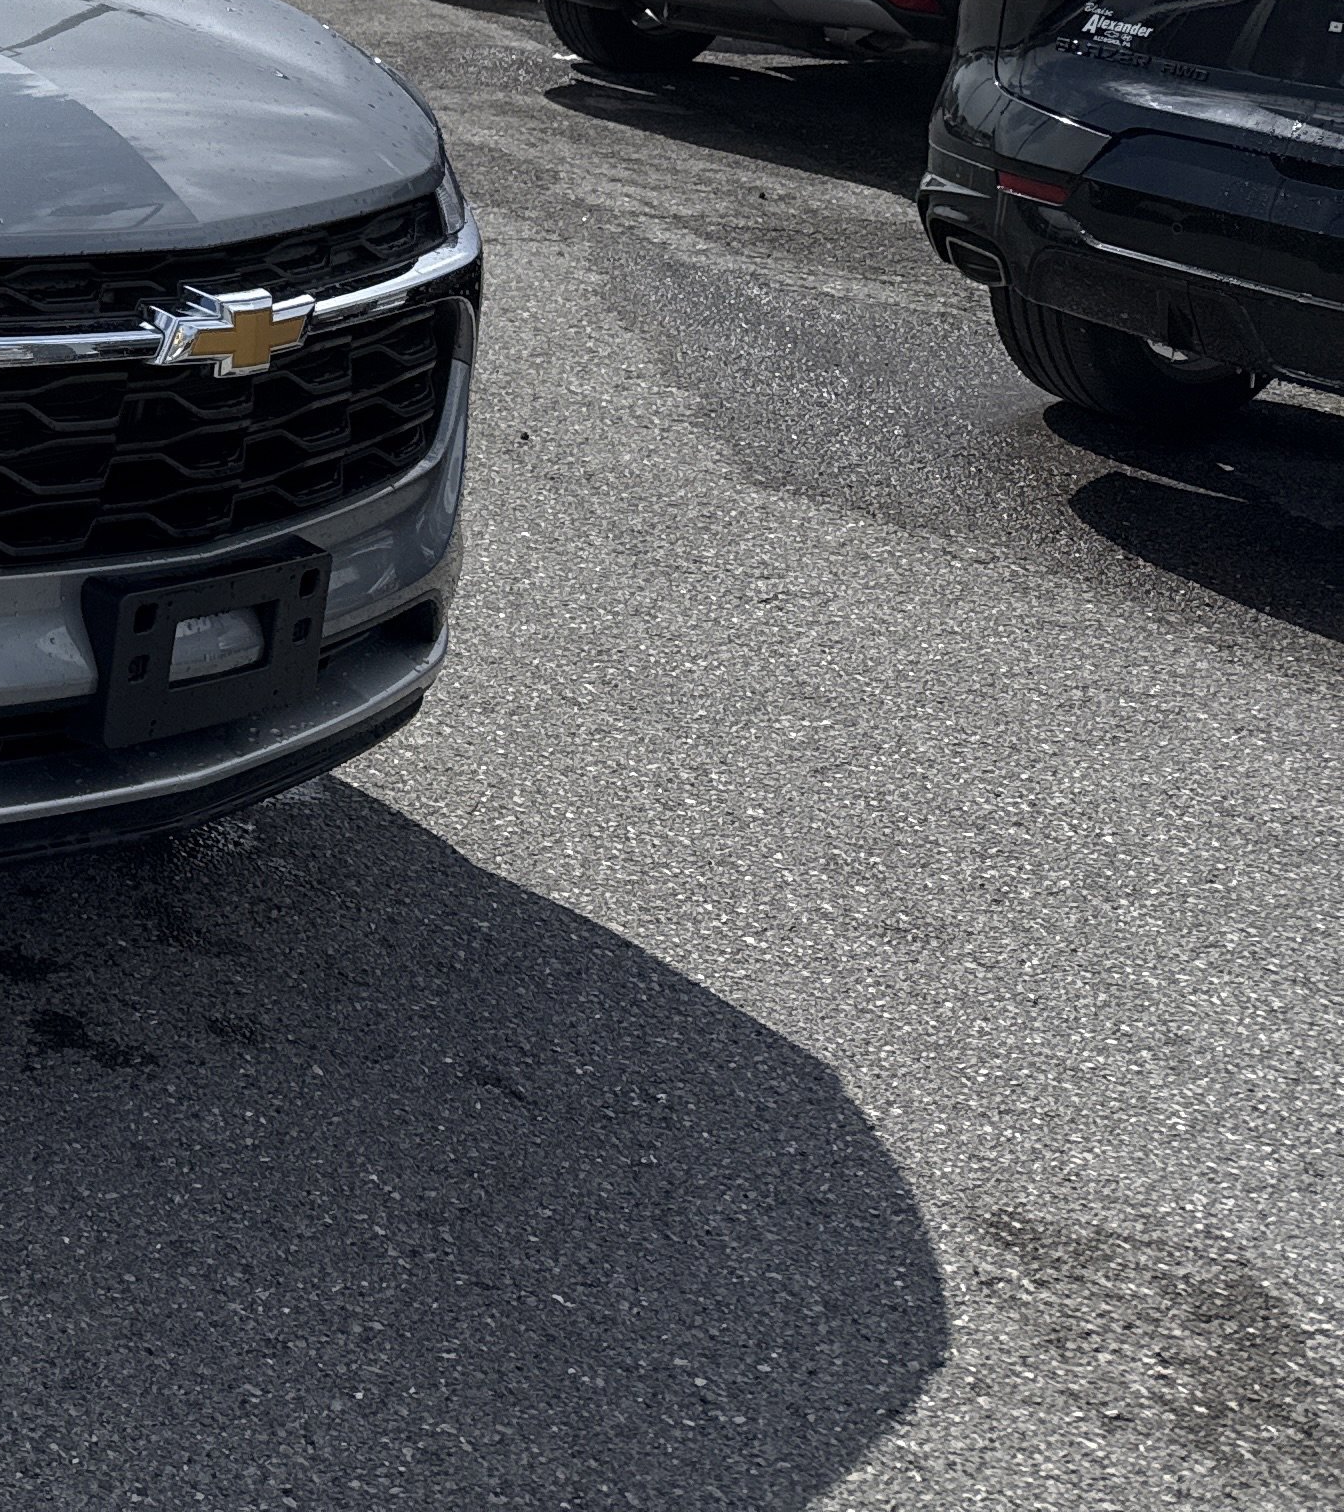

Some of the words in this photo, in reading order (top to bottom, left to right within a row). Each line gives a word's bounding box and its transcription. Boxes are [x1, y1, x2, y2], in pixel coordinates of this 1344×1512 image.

[1084, 2, 1114, 16] Blaise
[1081, 14, 1154, 38] Alexander
[1055, 36, 1152, 68] BLAZER
[1161, 61, 1210, 82] AWD
